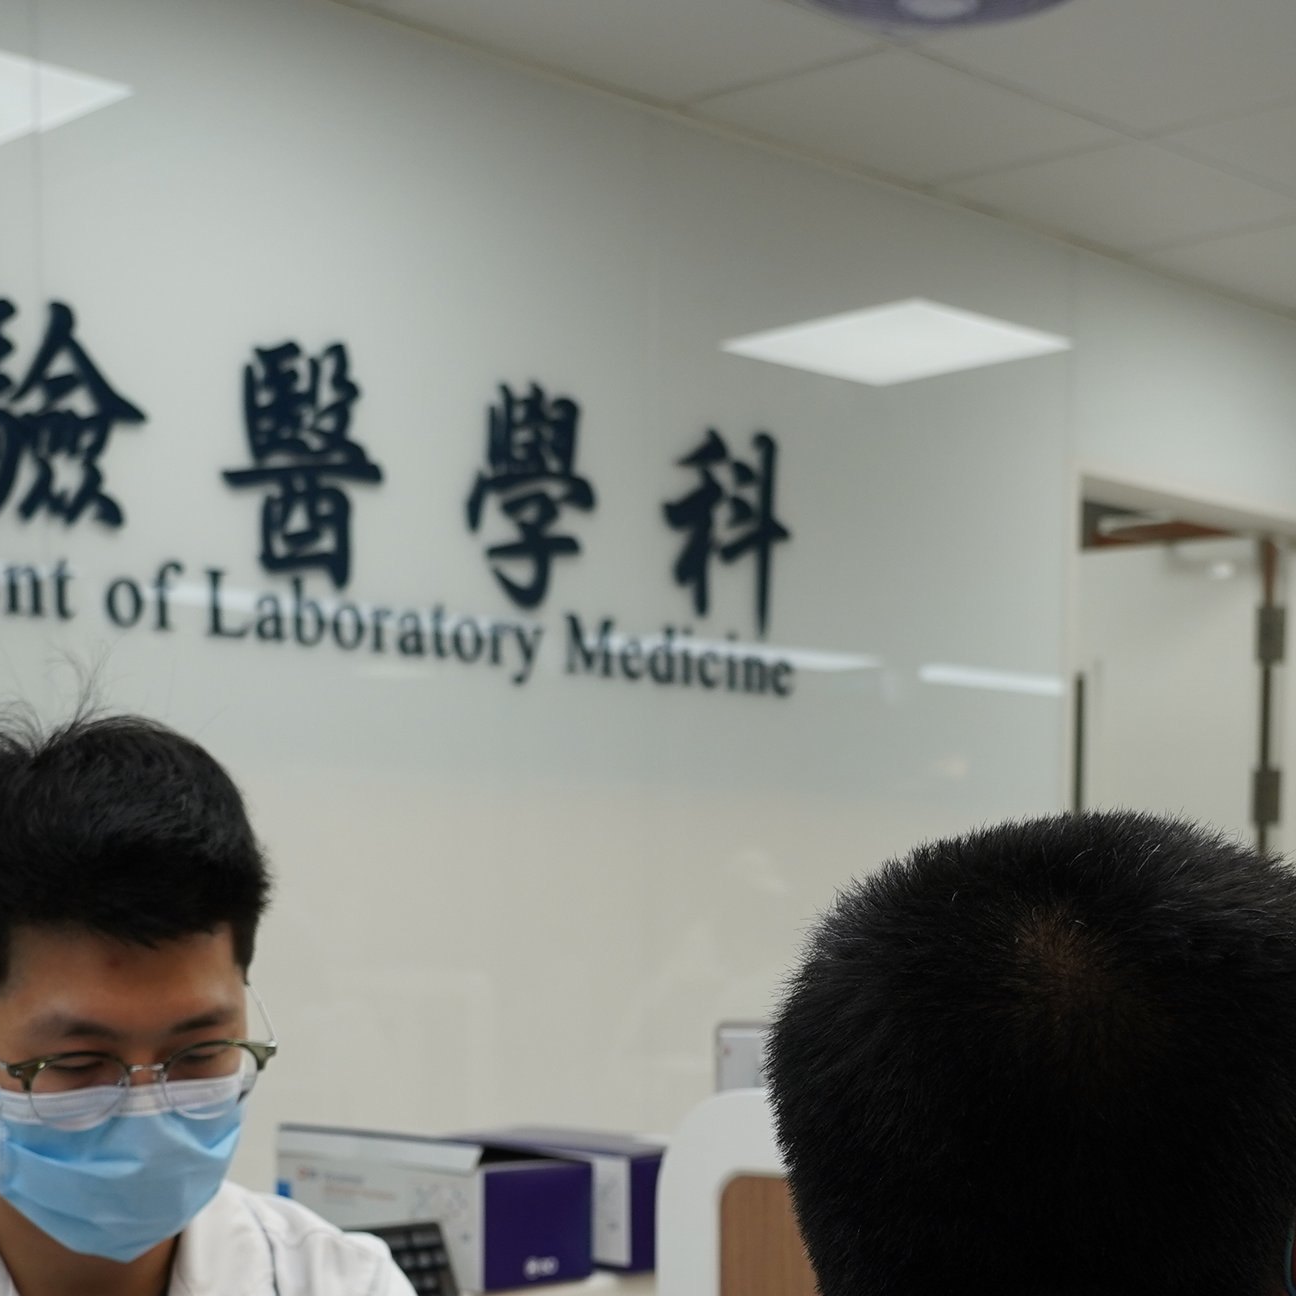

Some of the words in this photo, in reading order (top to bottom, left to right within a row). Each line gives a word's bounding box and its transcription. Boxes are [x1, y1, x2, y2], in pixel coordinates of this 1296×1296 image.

[105, 561, 185, 632] of
[205, 568, 546, 686] Laboratory
[565, 613, 796, 698] Medicine
